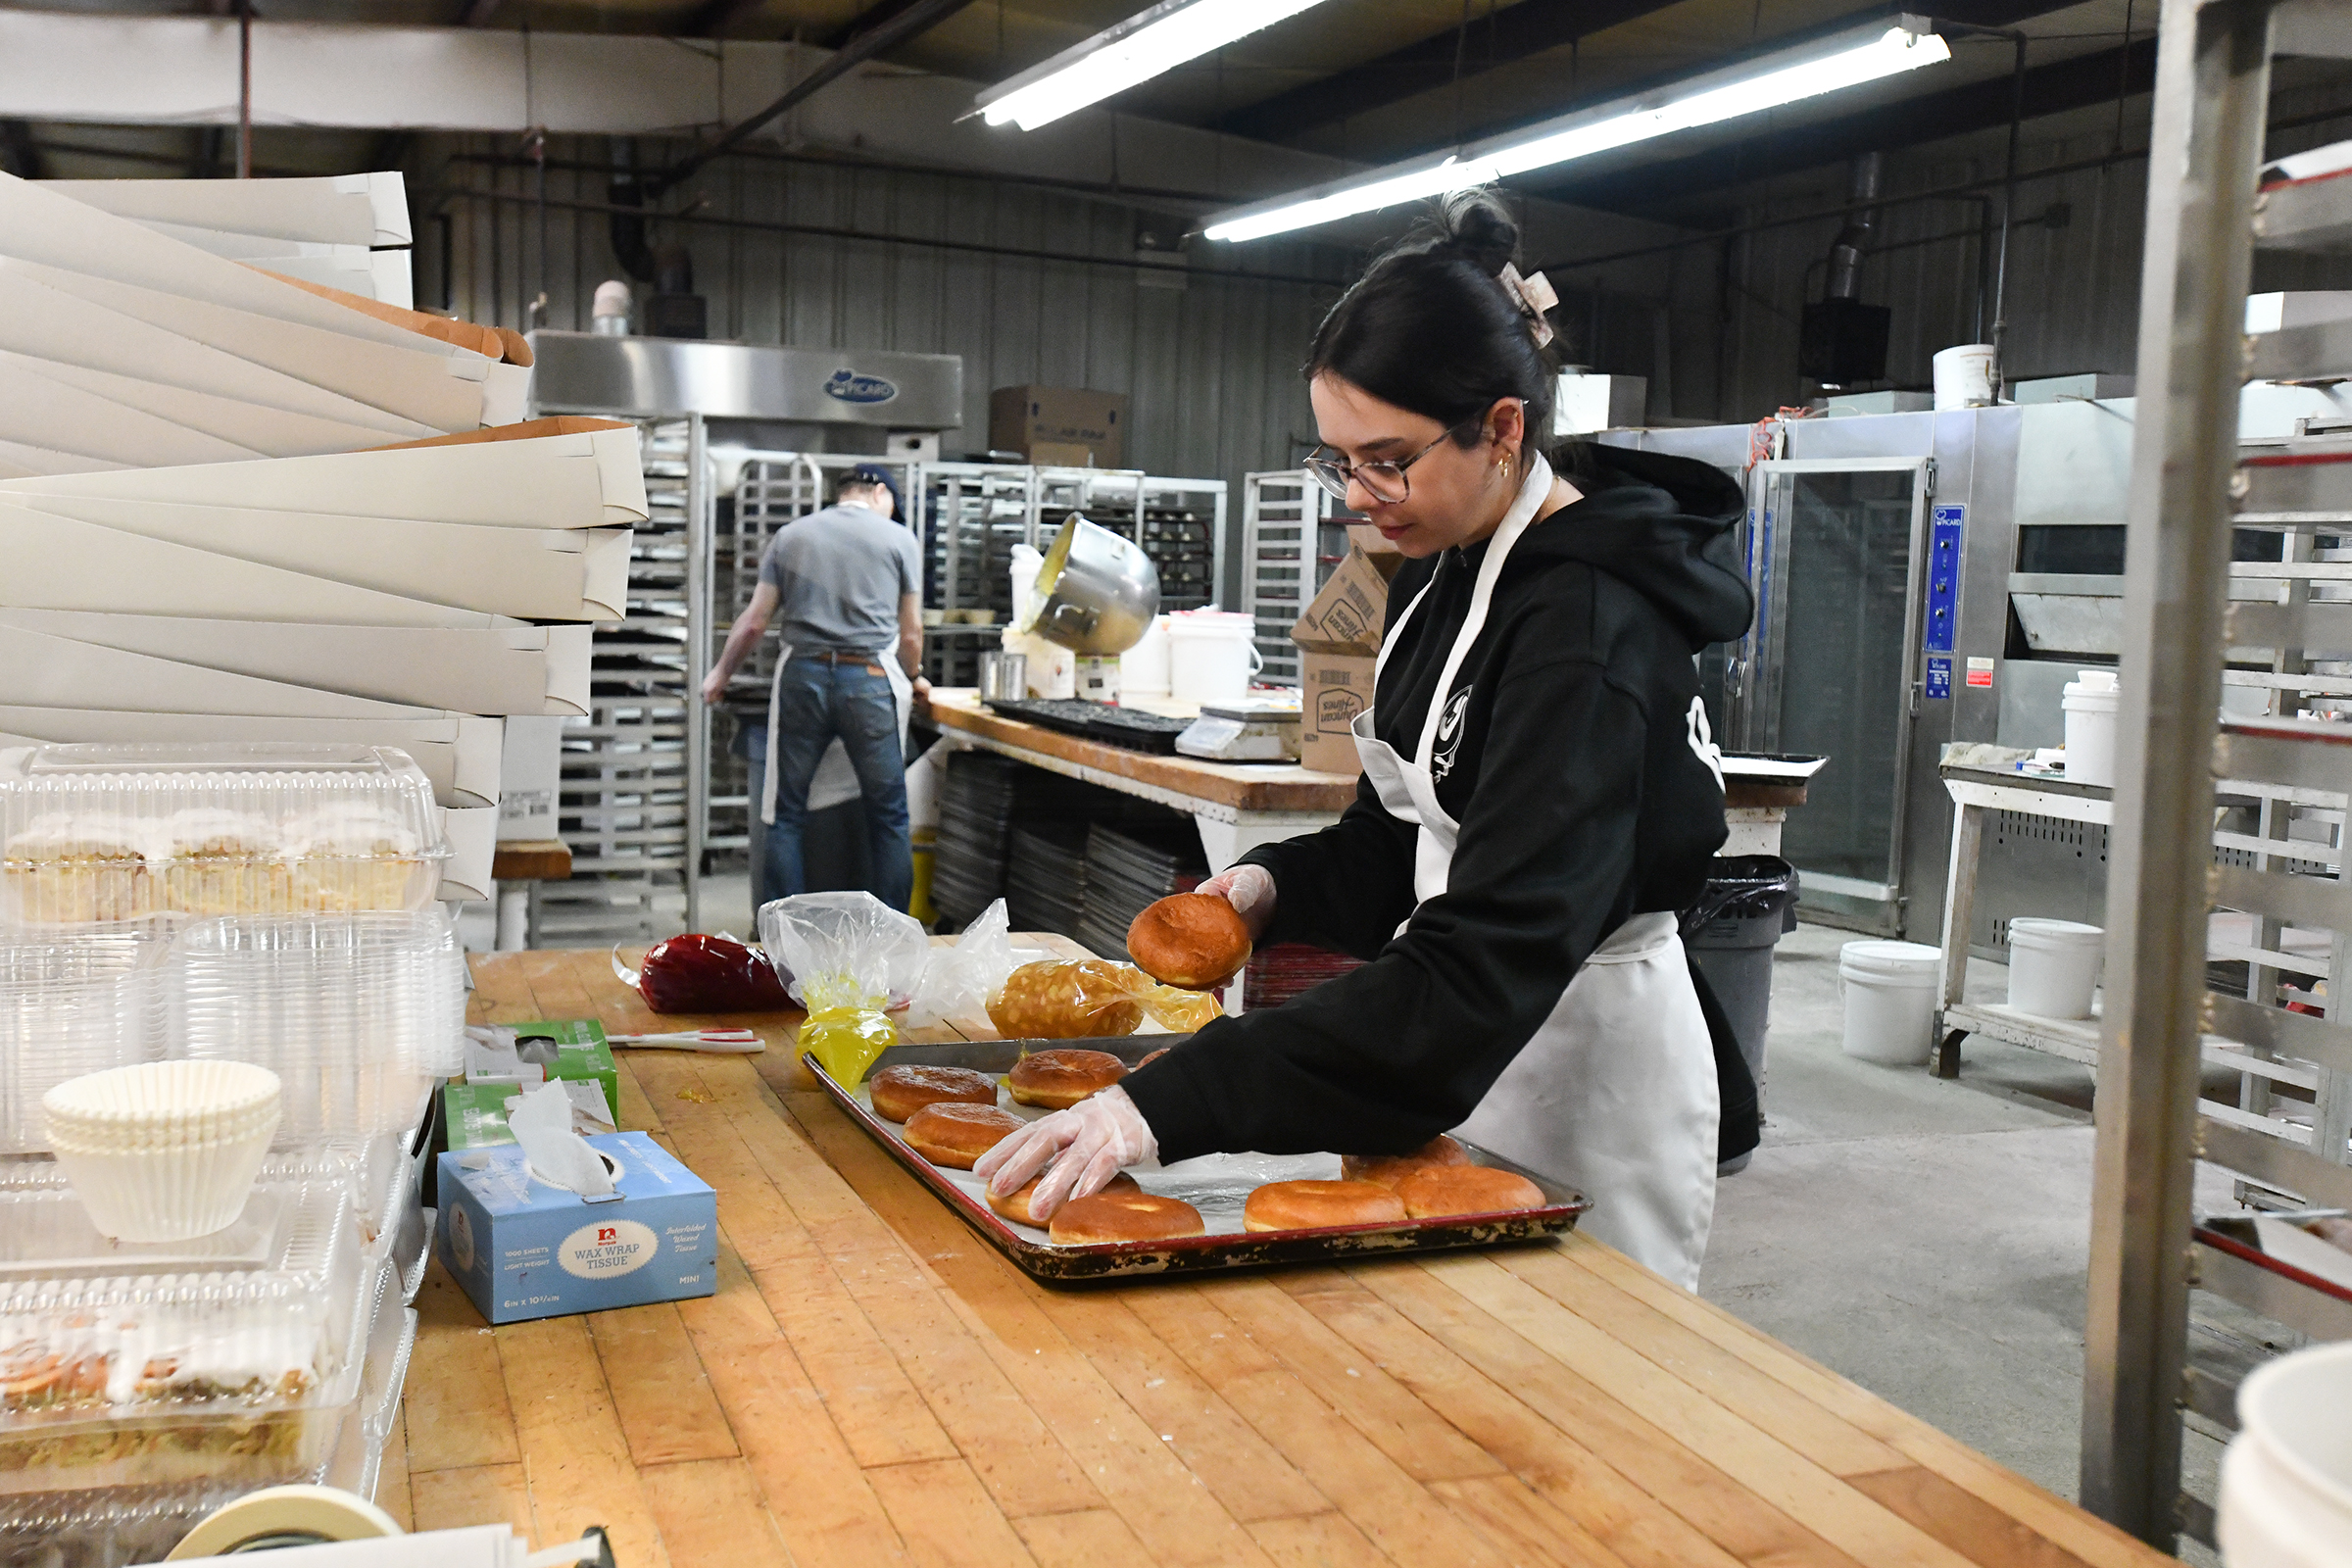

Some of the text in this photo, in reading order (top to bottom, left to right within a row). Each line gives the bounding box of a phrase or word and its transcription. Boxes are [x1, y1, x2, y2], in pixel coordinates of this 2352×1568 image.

[1942, 518, 1961, 527] PICARD
[1323, 697, 1354, 711] Hines
[665, 1223, 707, 1235] Interfolded
[672, 1233, 700, 1244] Waxed
[523, 1247, 549, 1255] SHEETS
[574, 1244, 640, 1260] WAX WRAP
[674, 1245, 698, 1253] Tissue
[504, 1259, 550, 1271] LIGHT WEIGHT
[586, 1255, 628, 1270] TISSUE
[679, 1275, 700, 1285] MINI
